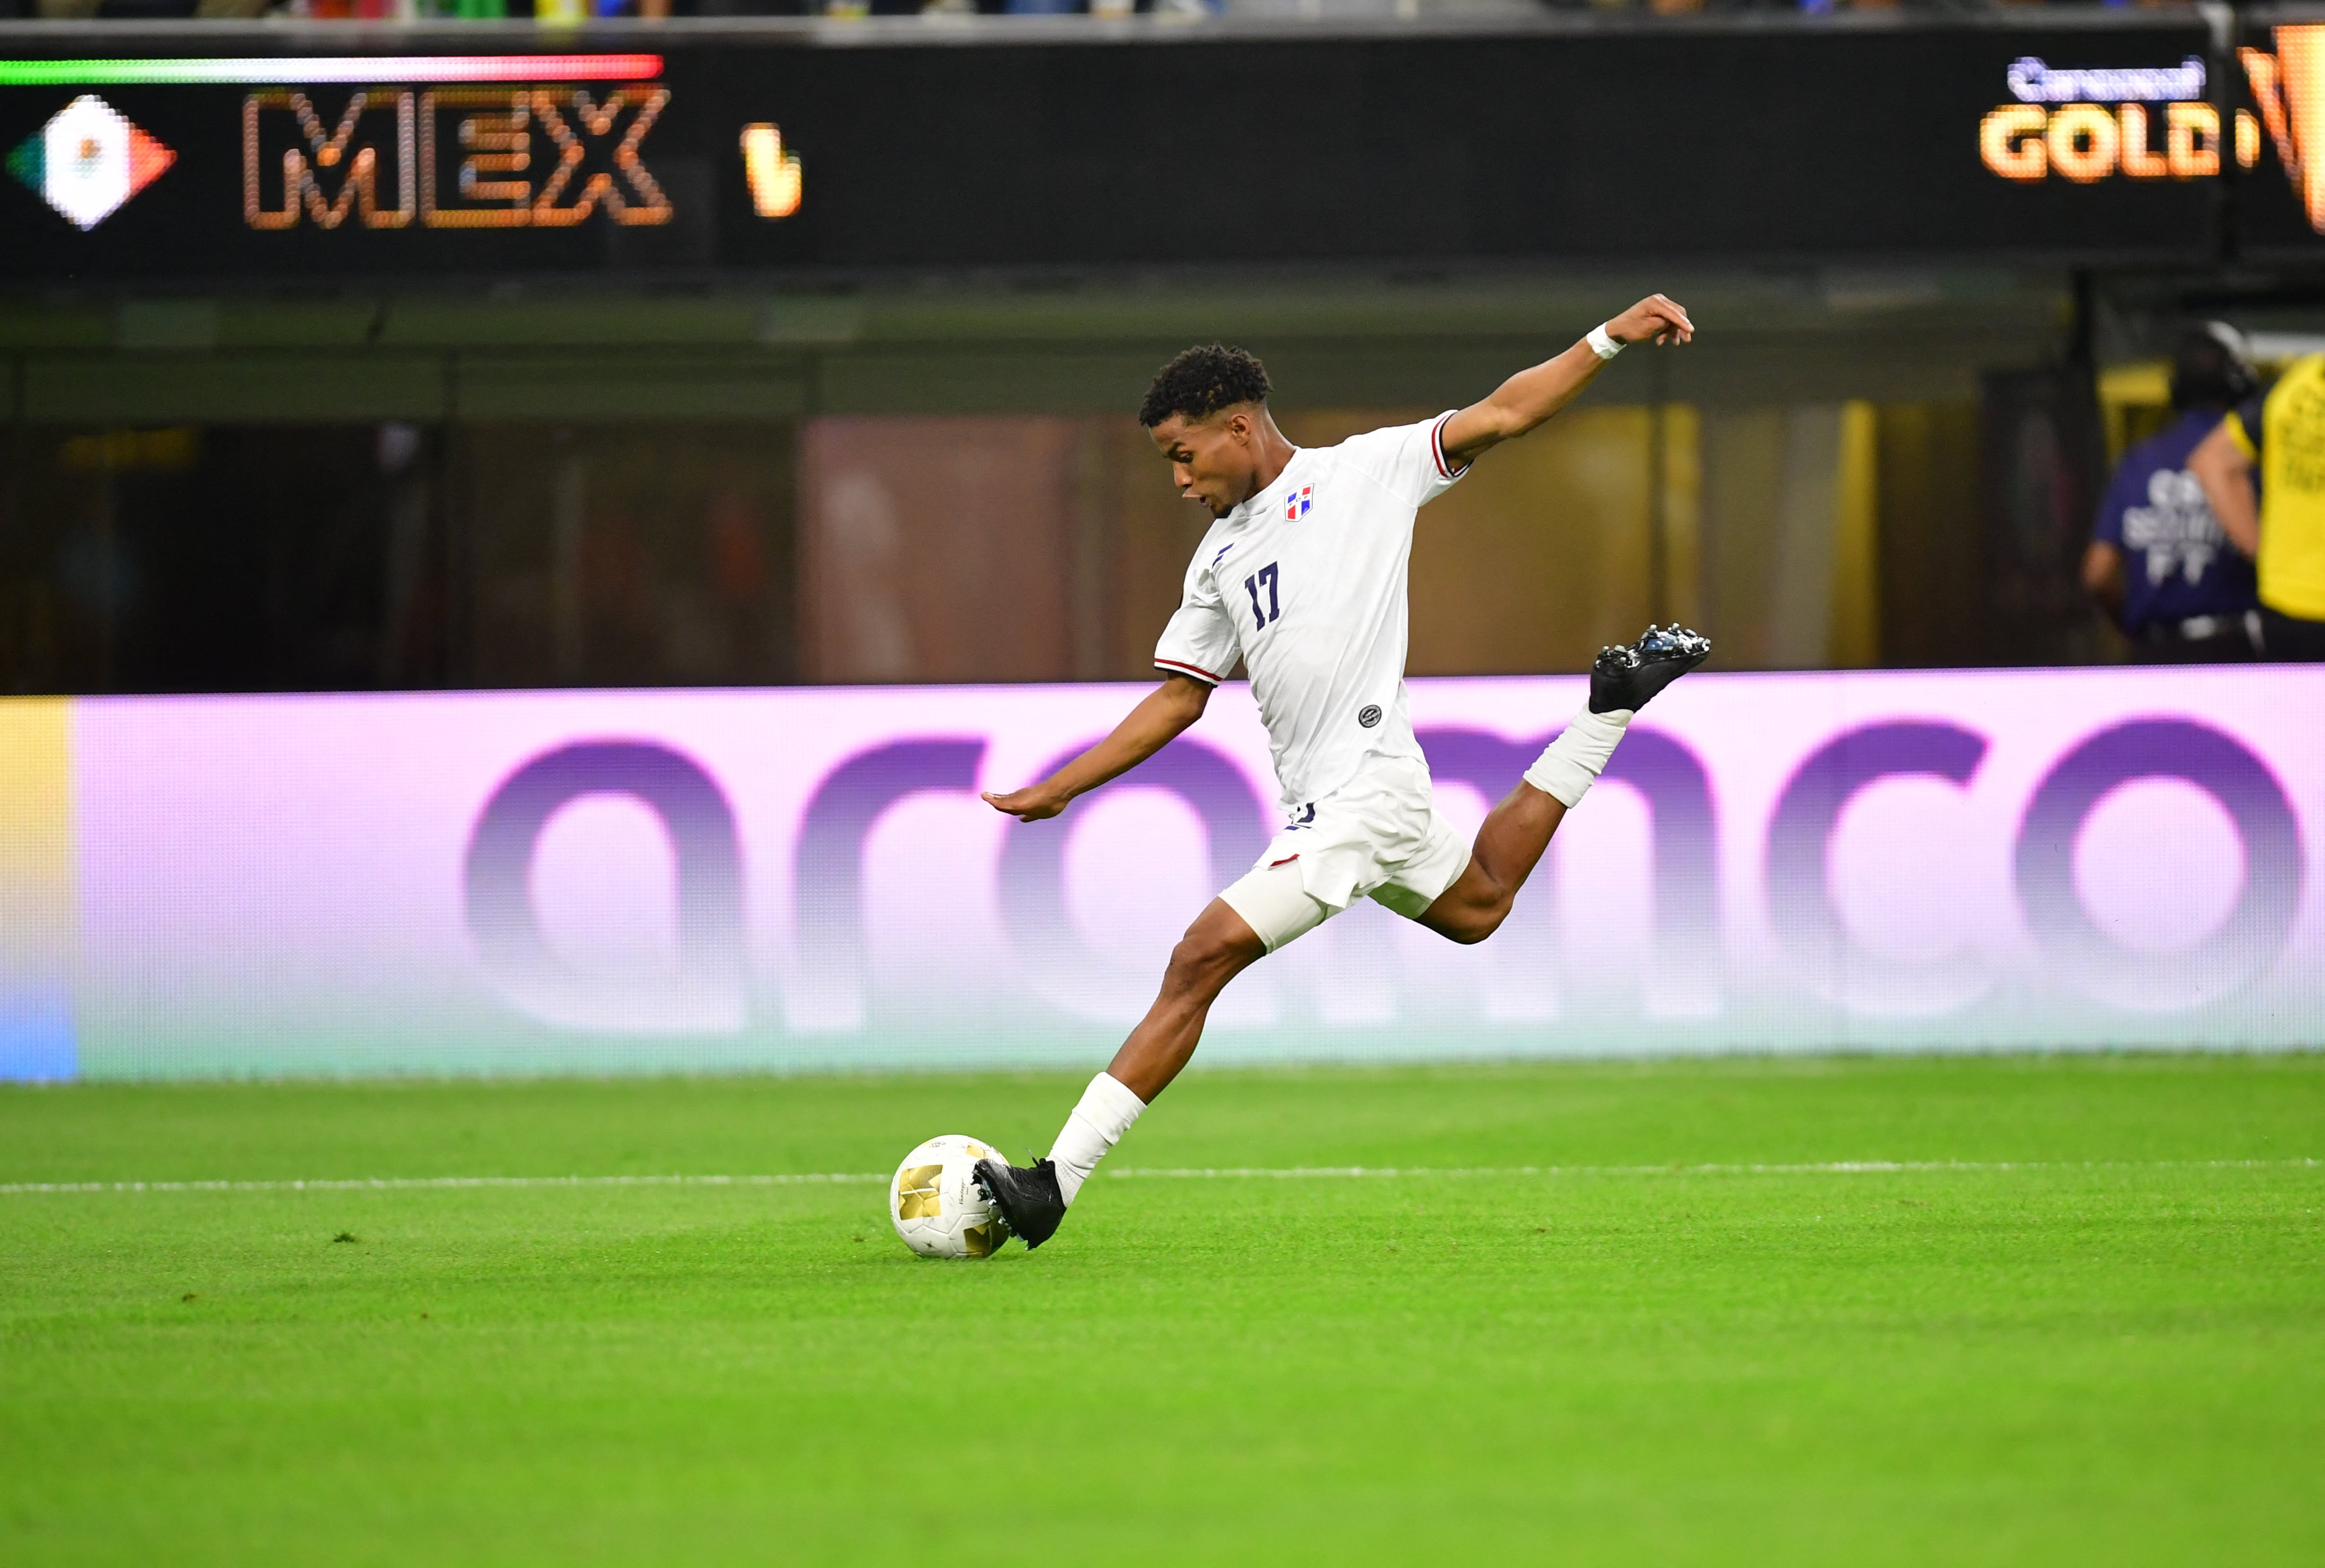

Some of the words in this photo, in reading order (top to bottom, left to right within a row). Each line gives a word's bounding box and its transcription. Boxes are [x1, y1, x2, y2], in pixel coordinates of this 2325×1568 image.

[244, 85, 674, 230] MEX
[1979, 102, 2260, 184] GOLD
[1245, 561, 1280, 632] 17
[464, 716, 2304, 1033] aramco
